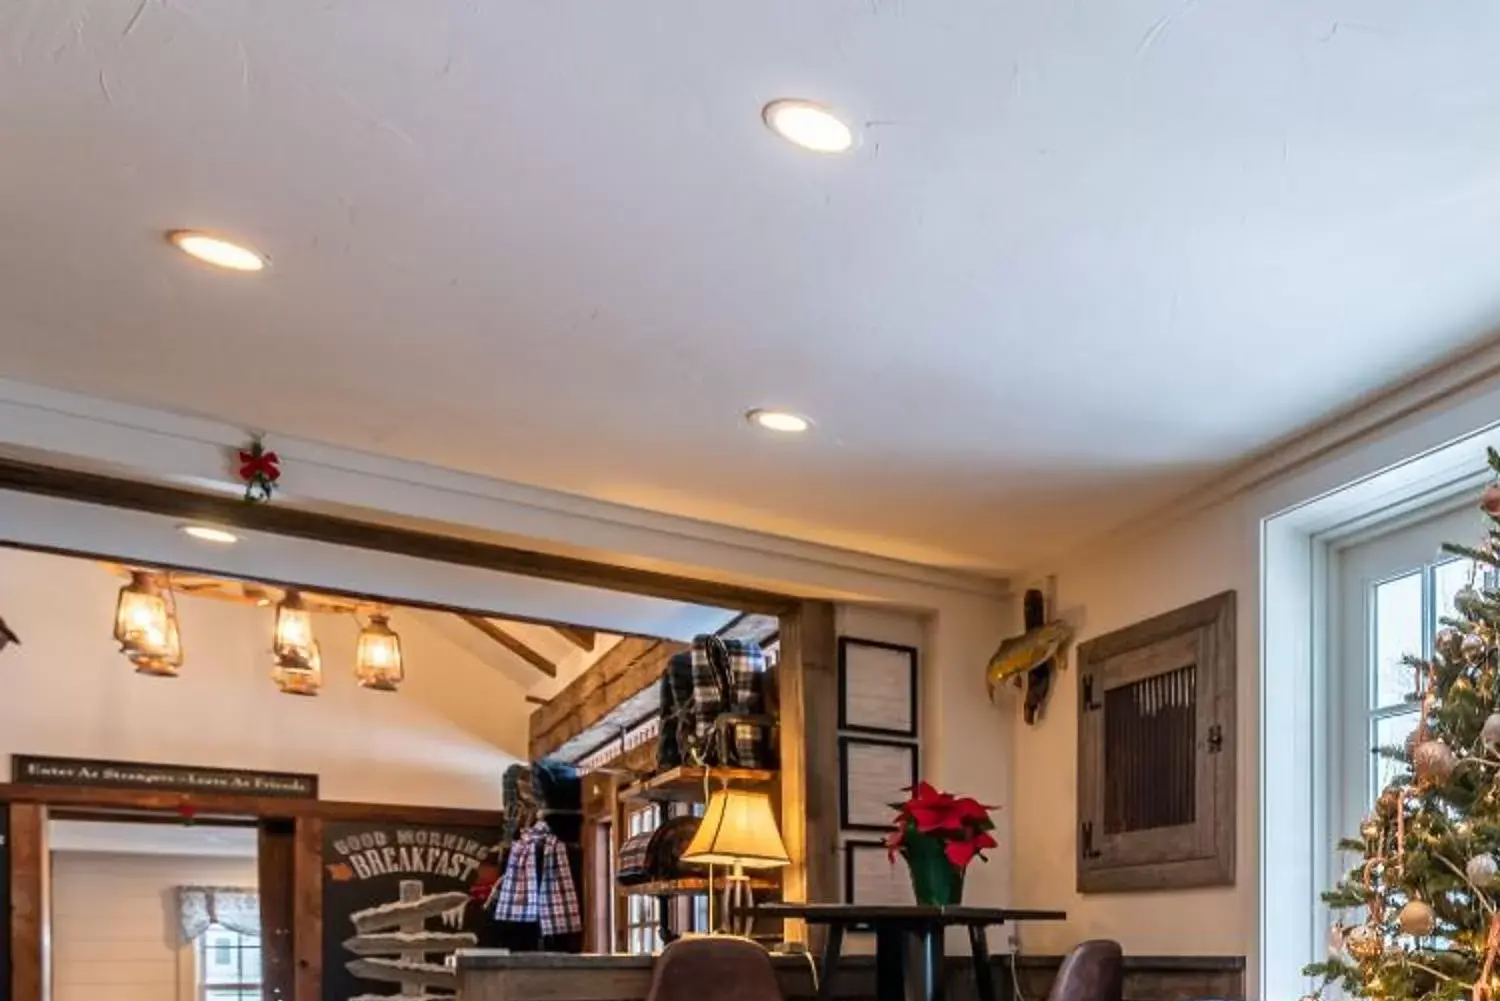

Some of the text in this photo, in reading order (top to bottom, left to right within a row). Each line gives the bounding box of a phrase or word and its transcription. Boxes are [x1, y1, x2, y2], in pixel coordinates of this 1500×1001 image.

[28, 763, 74, 776] Enter
[78, 766, 98, 779] As
[102, 768, 174, 784] Strangers
[188, 773, 227, 786] Leave
[231, 777, 250, 788] As
[254, 777, 305, 791] Friends
[333, 829, 490, 860] GOOD MORNING
[348, 847, 480, 881] BREAKFAST
